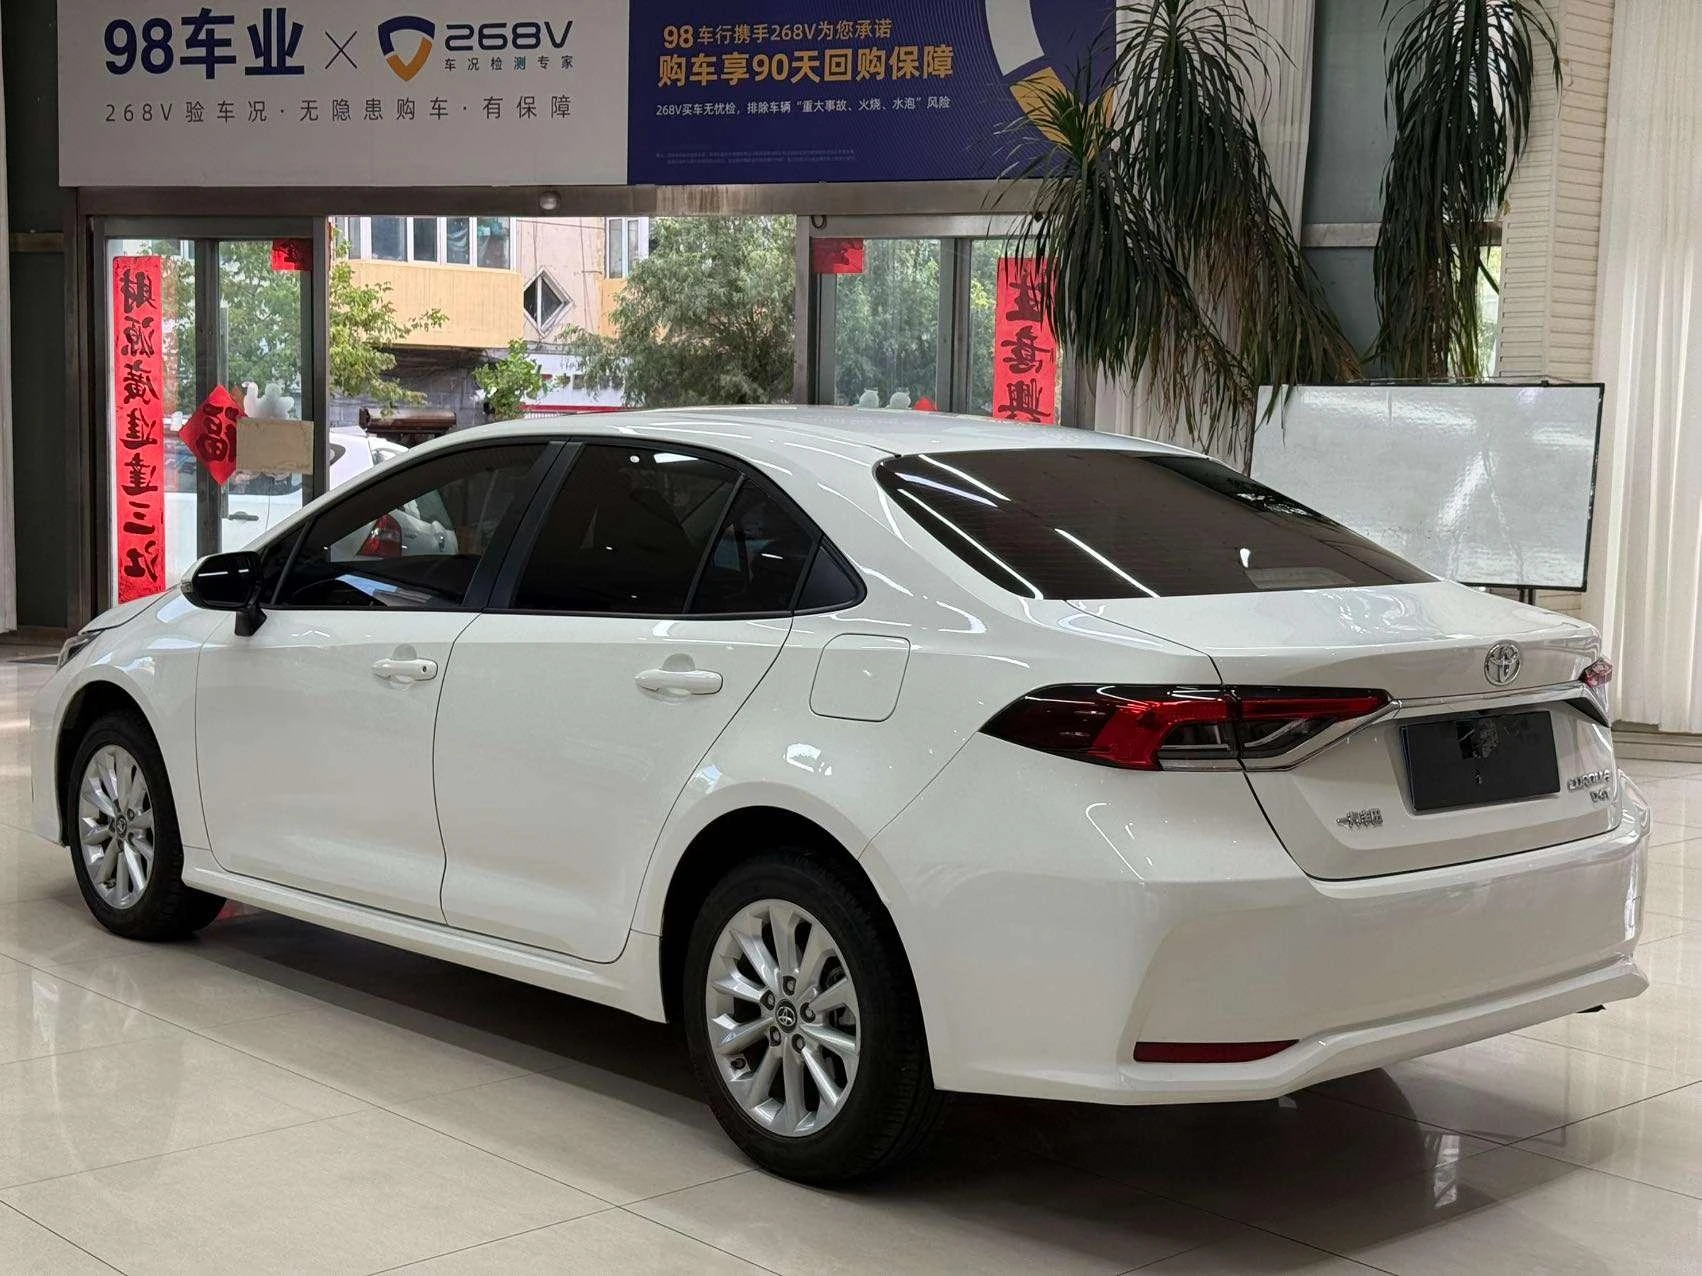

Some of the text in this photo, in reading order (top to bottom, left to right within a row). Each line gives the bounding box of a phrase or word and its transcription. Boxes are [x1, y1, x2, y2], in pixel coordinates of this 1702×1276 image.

[104, 7, 305, 79] 98车业
[444, 20, 573, 51] 268V
[444, 55, 574, 71] 车况检测专家
[657, 44, 955, 88] 购车享90天回购保障
